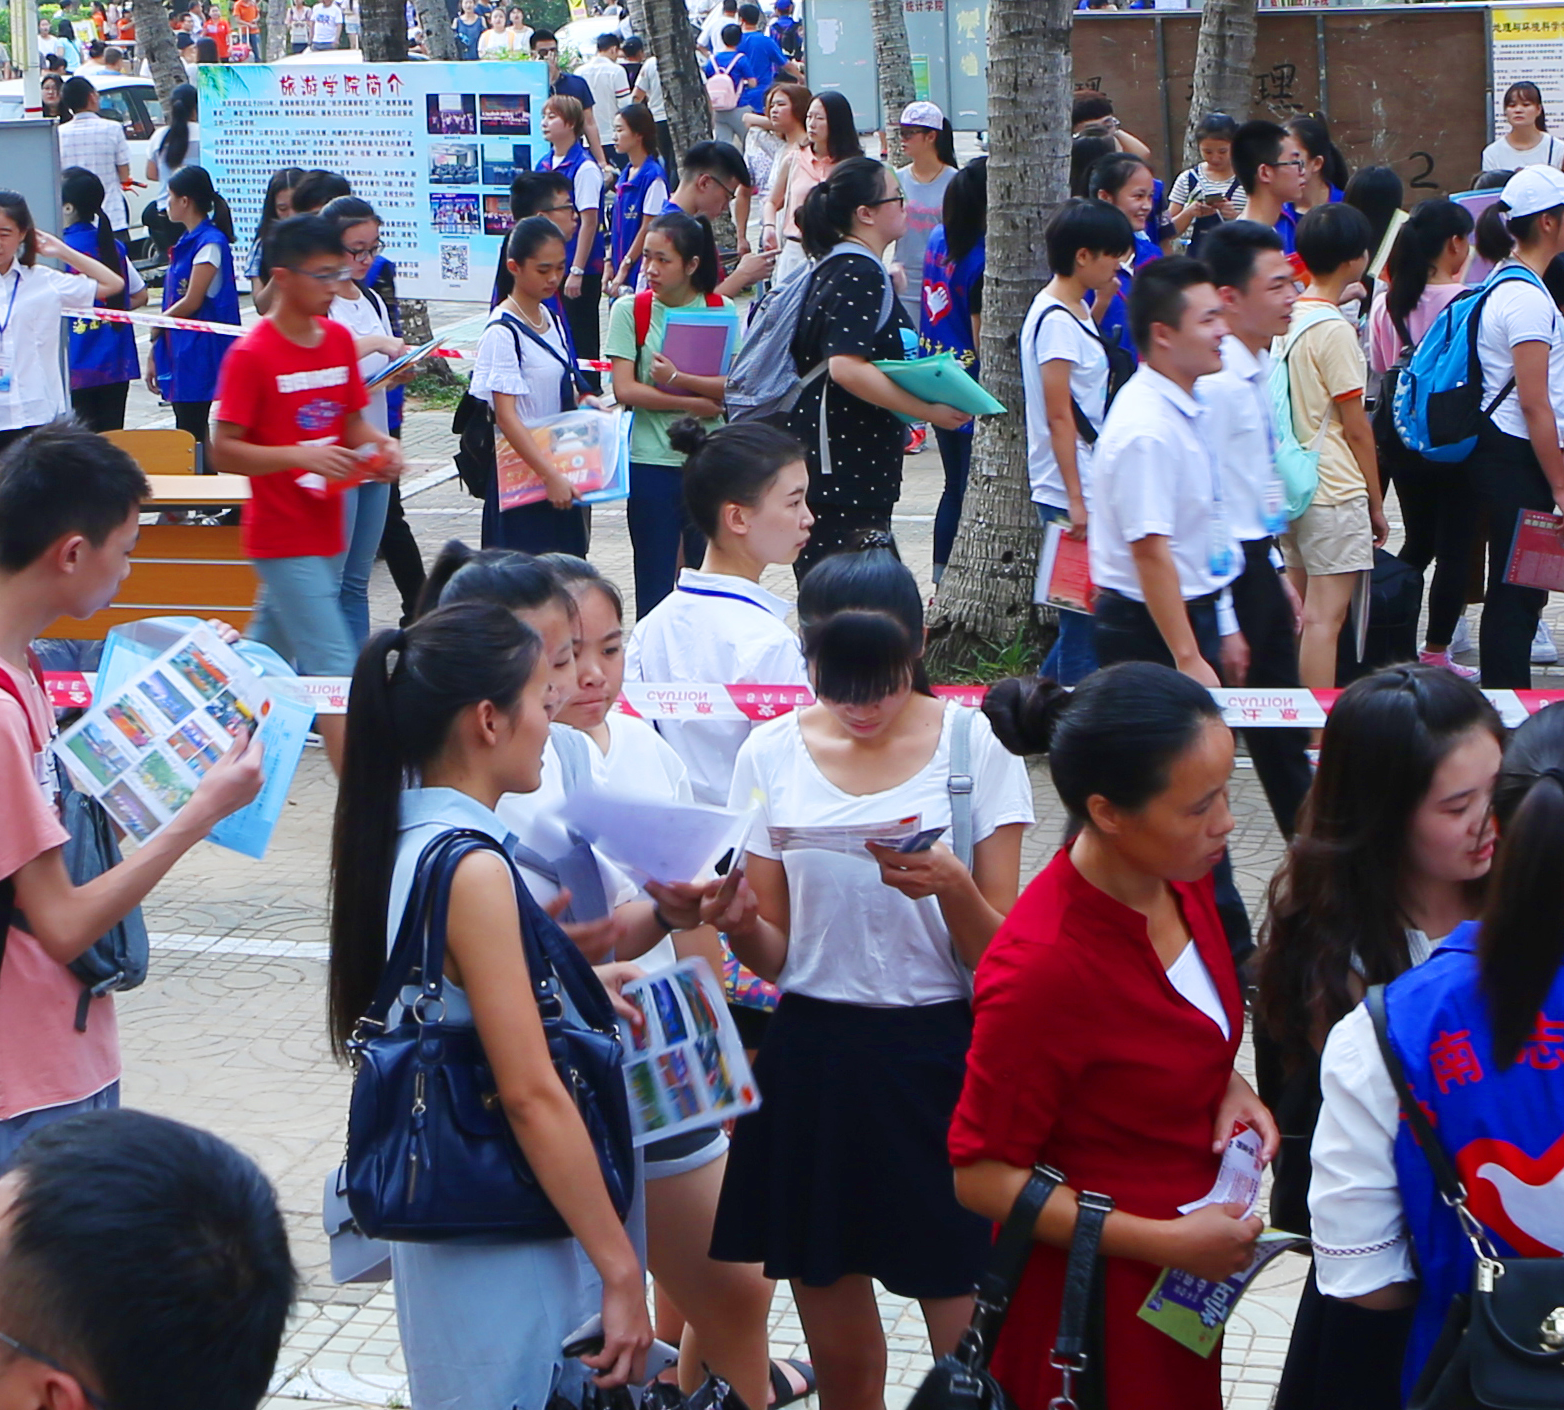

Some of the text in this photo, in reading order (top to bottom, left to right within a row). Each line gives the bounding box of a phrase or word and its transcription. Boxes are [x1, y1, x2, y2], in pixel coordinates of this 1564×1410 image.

[279, 73, 406, 98] 旅游学院简介
[1408, 151, 1439, 189] 2
